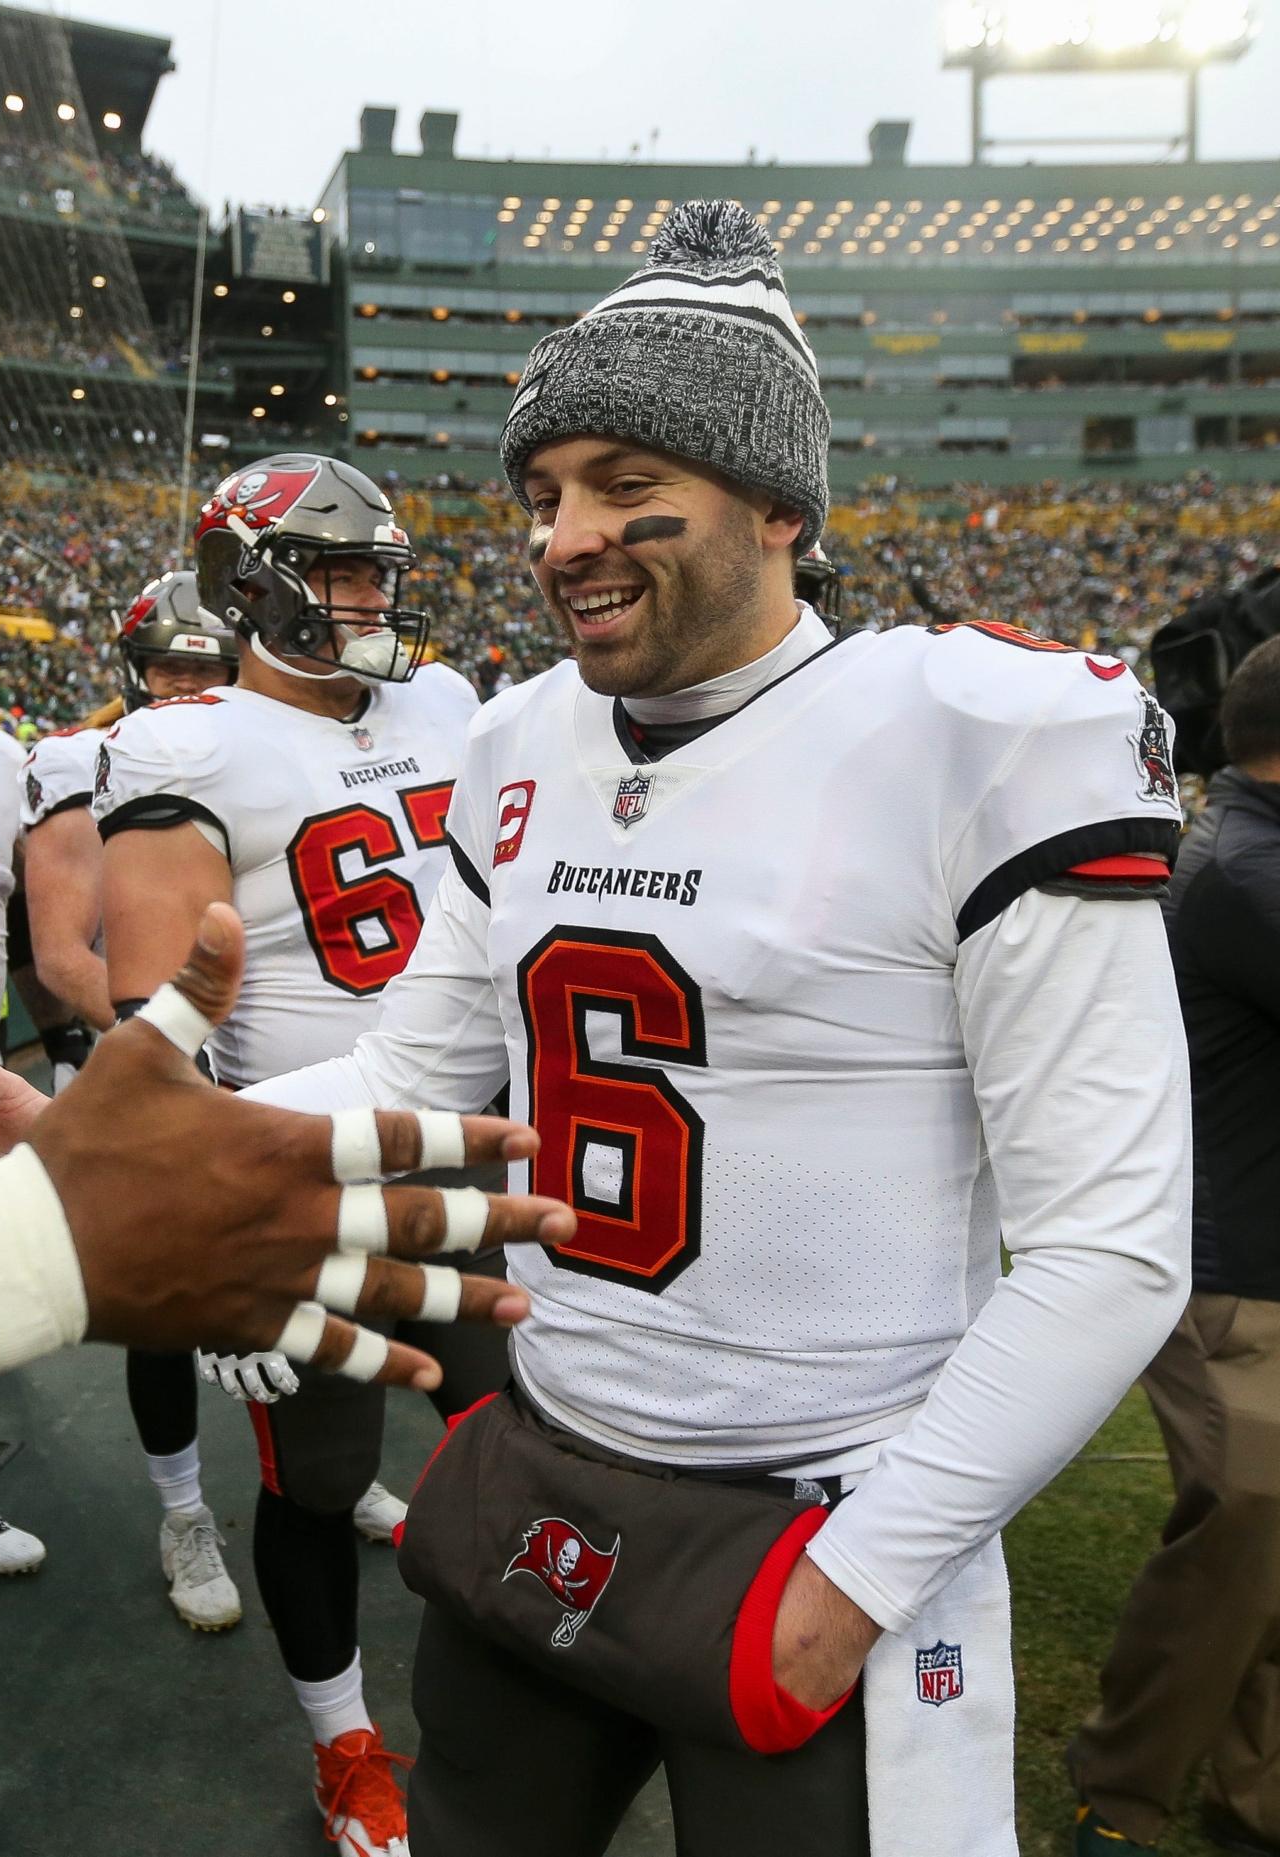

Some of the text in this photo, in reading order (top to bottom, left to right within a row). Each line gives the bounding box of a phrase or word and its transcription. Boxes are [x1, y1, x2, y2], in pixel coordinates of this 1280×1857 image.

[339, 757, 420, 788] BUCCANEERS
[498, 788, 528, 841] C
[615, 794, 642, 817] NFL
[546, 860, 703, 907] BUCCANEERS
[516, 923, 709, 1296] 6
[920, 1669, 961, 1701] NFL
